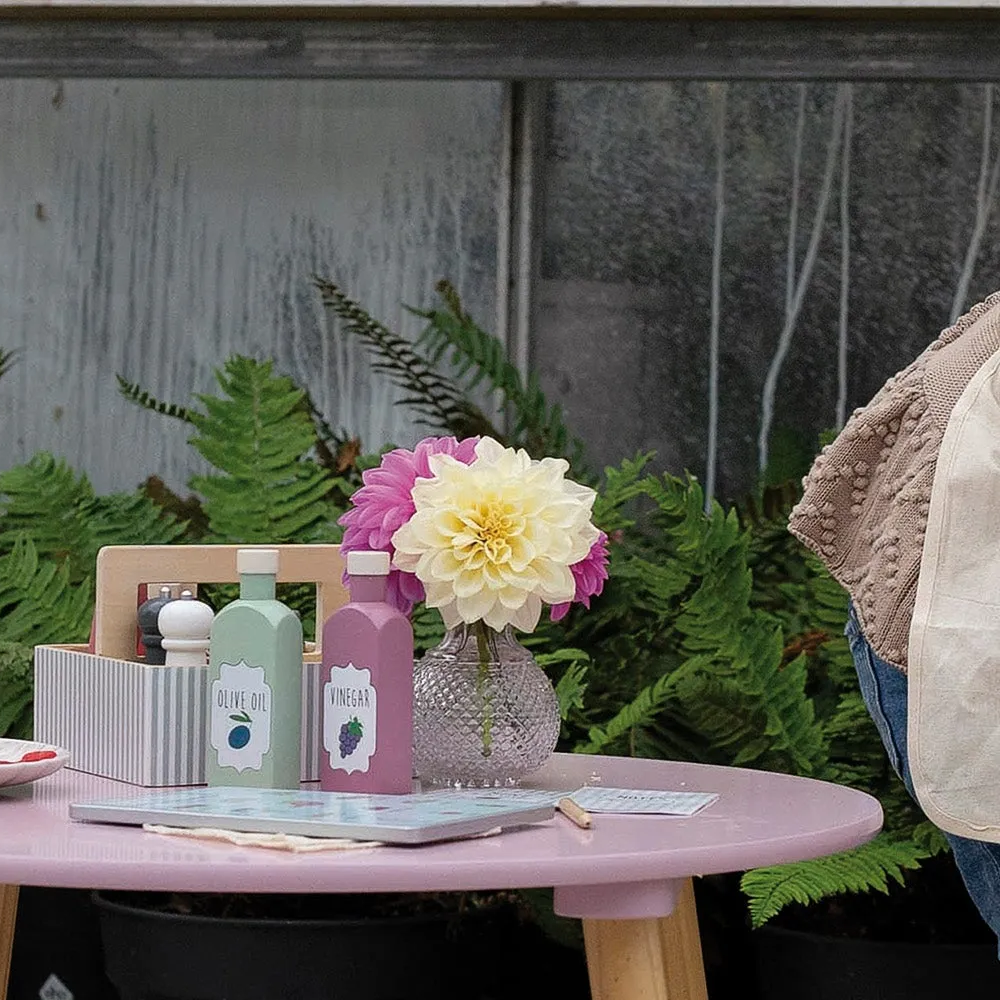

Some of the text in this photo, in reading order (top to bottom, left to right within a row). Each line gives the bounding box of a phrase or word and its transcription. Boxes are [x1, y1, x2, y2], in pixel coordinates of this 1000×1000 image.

[217, 689, 267, 712] OLIVE OIL
[330, 687, 370, 708] VINEGAR
